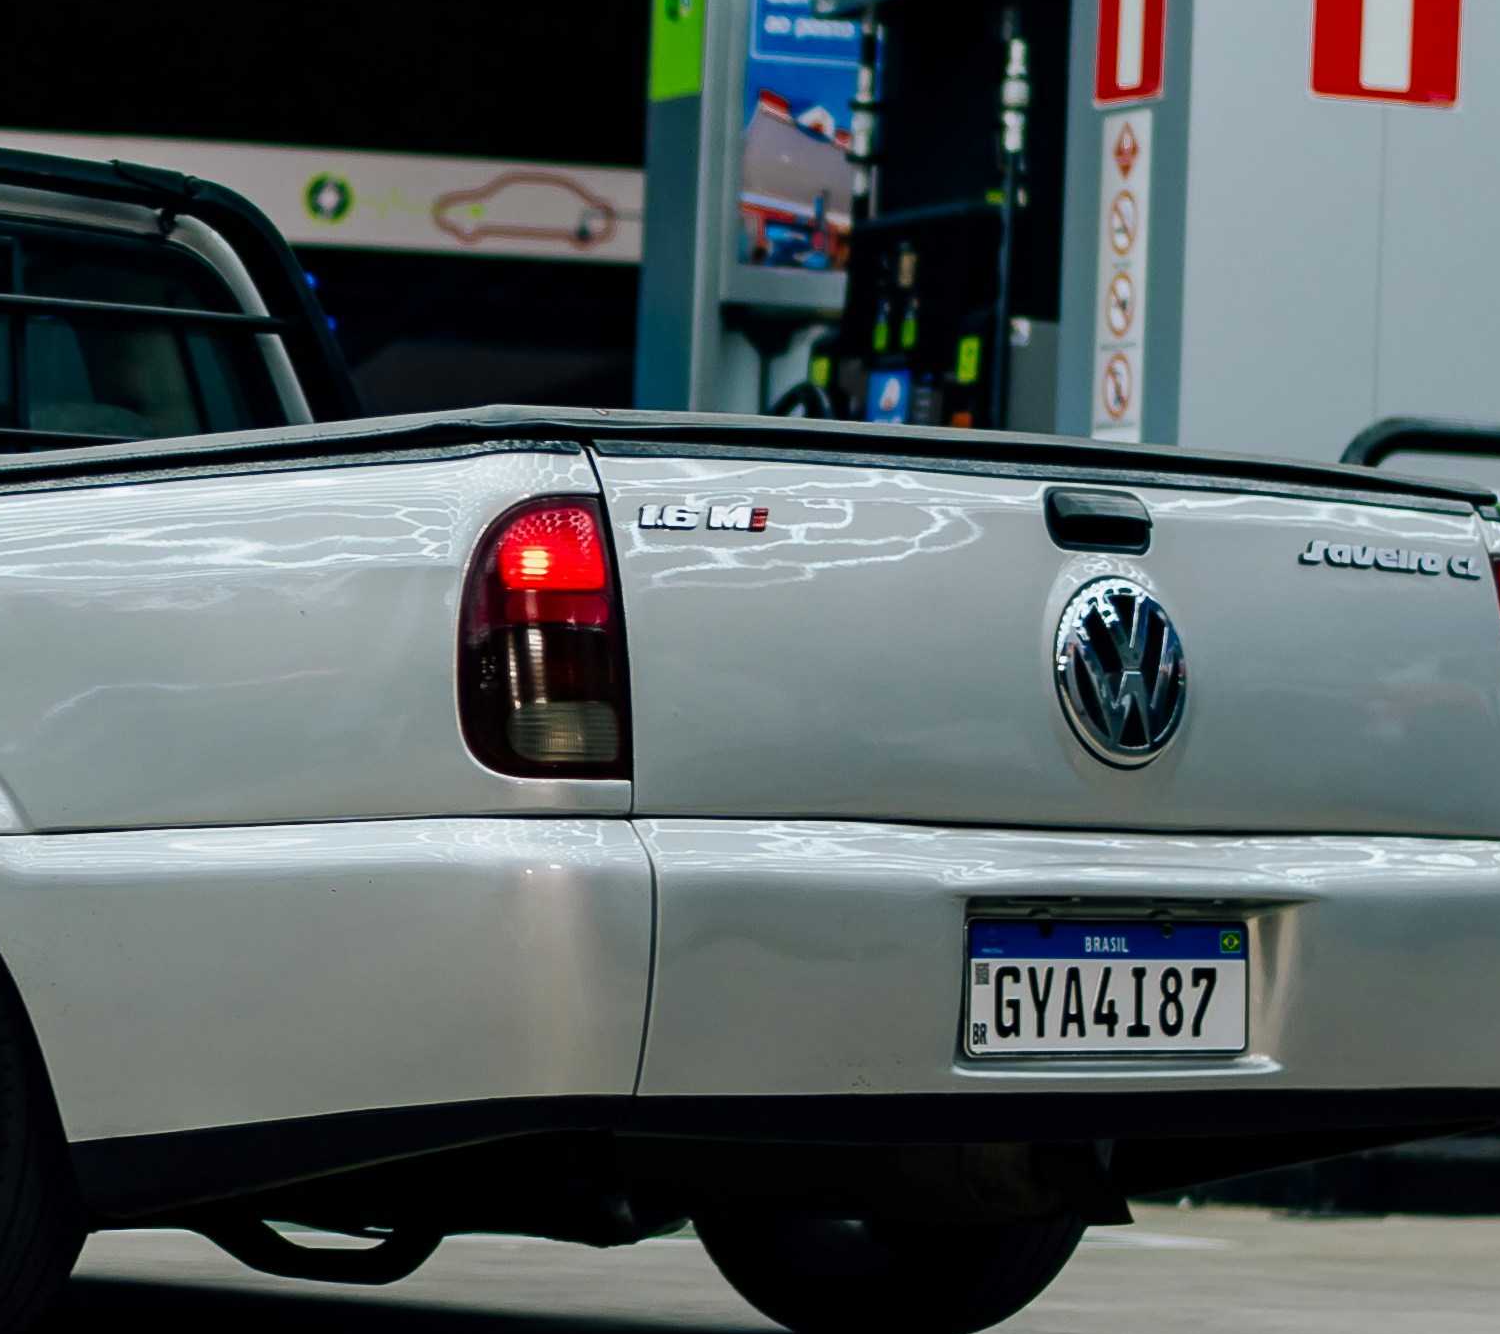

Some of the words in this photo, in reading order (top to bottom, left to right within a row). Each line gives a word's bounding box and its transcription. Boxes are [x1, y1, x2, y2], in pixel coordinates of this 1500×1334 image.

[639, 504, 700, 529] 1.6
[1299, 540, 1443, 575] Saveiro
[1085, 936, 1129, 953] BRASIL
[973, 1023, 987, 1045] BR
